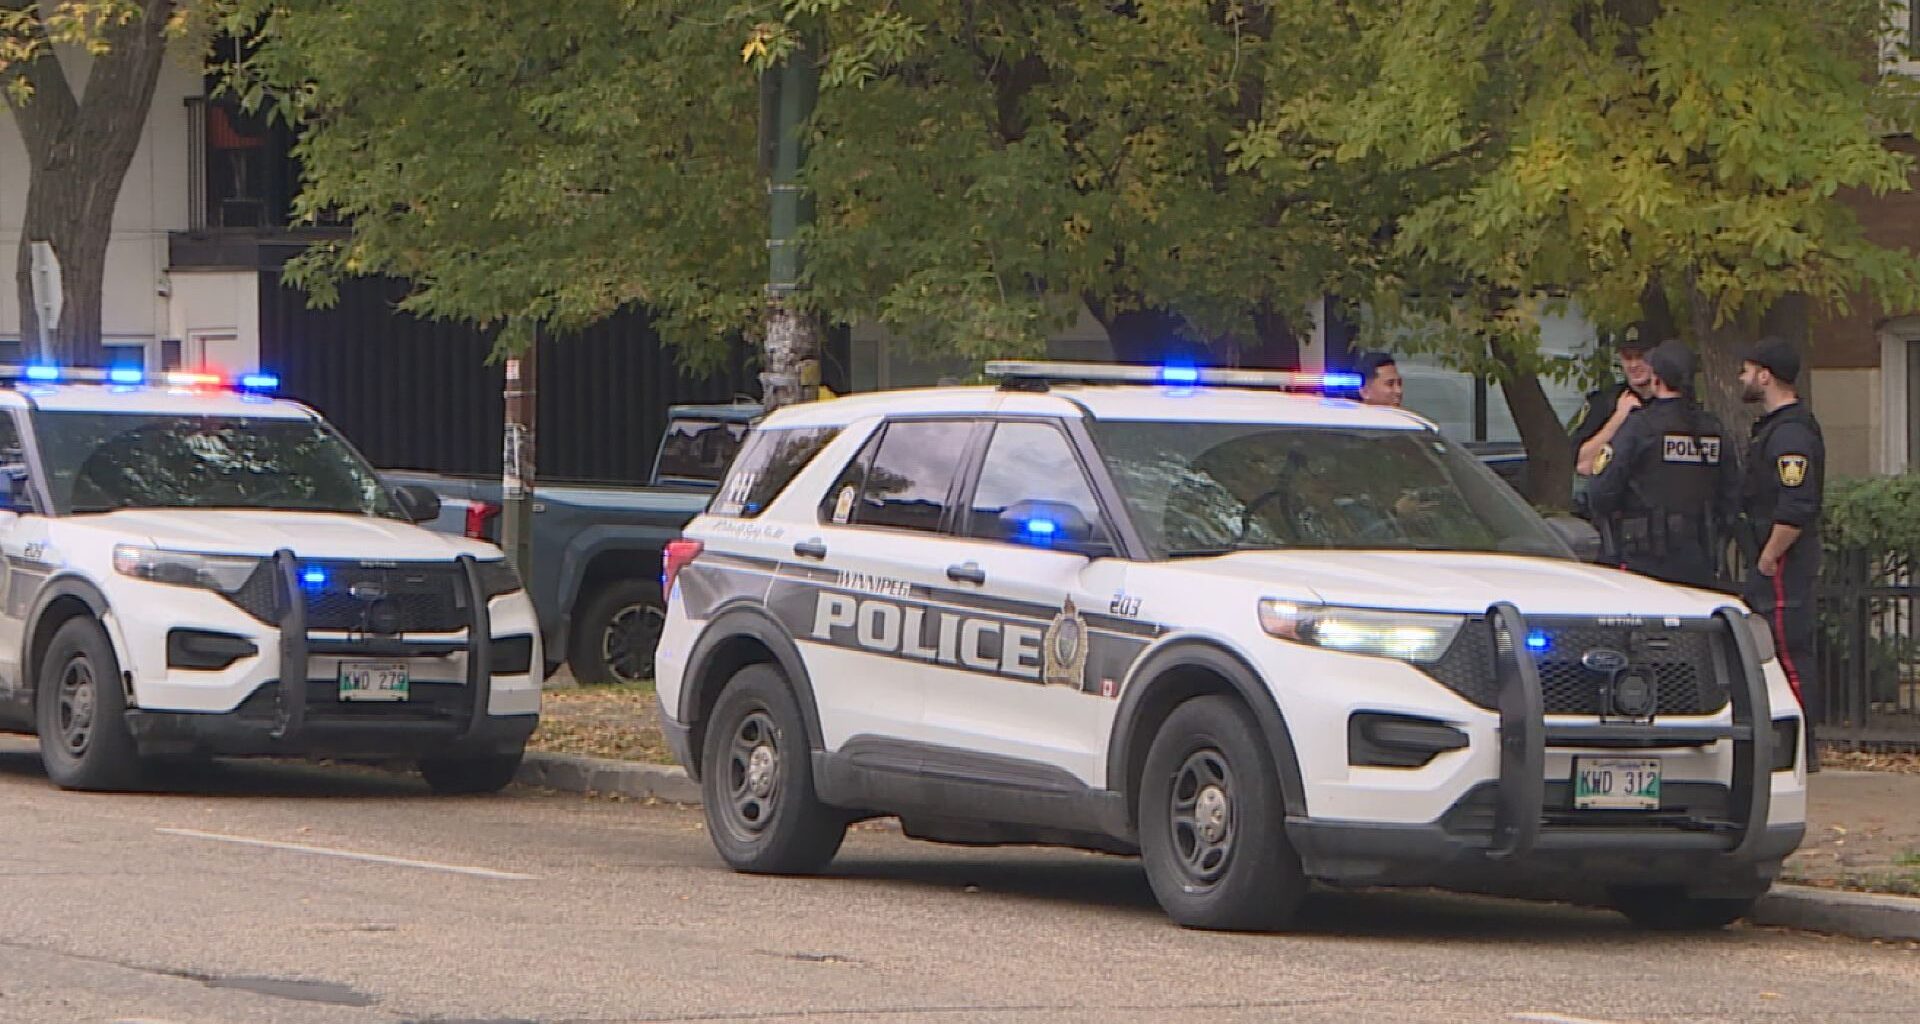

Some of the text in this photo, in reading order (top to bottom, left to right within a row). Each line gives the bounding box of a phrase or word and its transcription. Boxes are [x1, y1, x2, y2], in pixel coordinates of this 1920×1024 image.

[837, 569, 911, 598] WINNIPEG
[1110, 594, 1142, 615] 203
[811, 591, 1042, 676] POLICE
[342, 671, 370, 690] KWD
[1580, 771, 1657, 794] KWD 312
